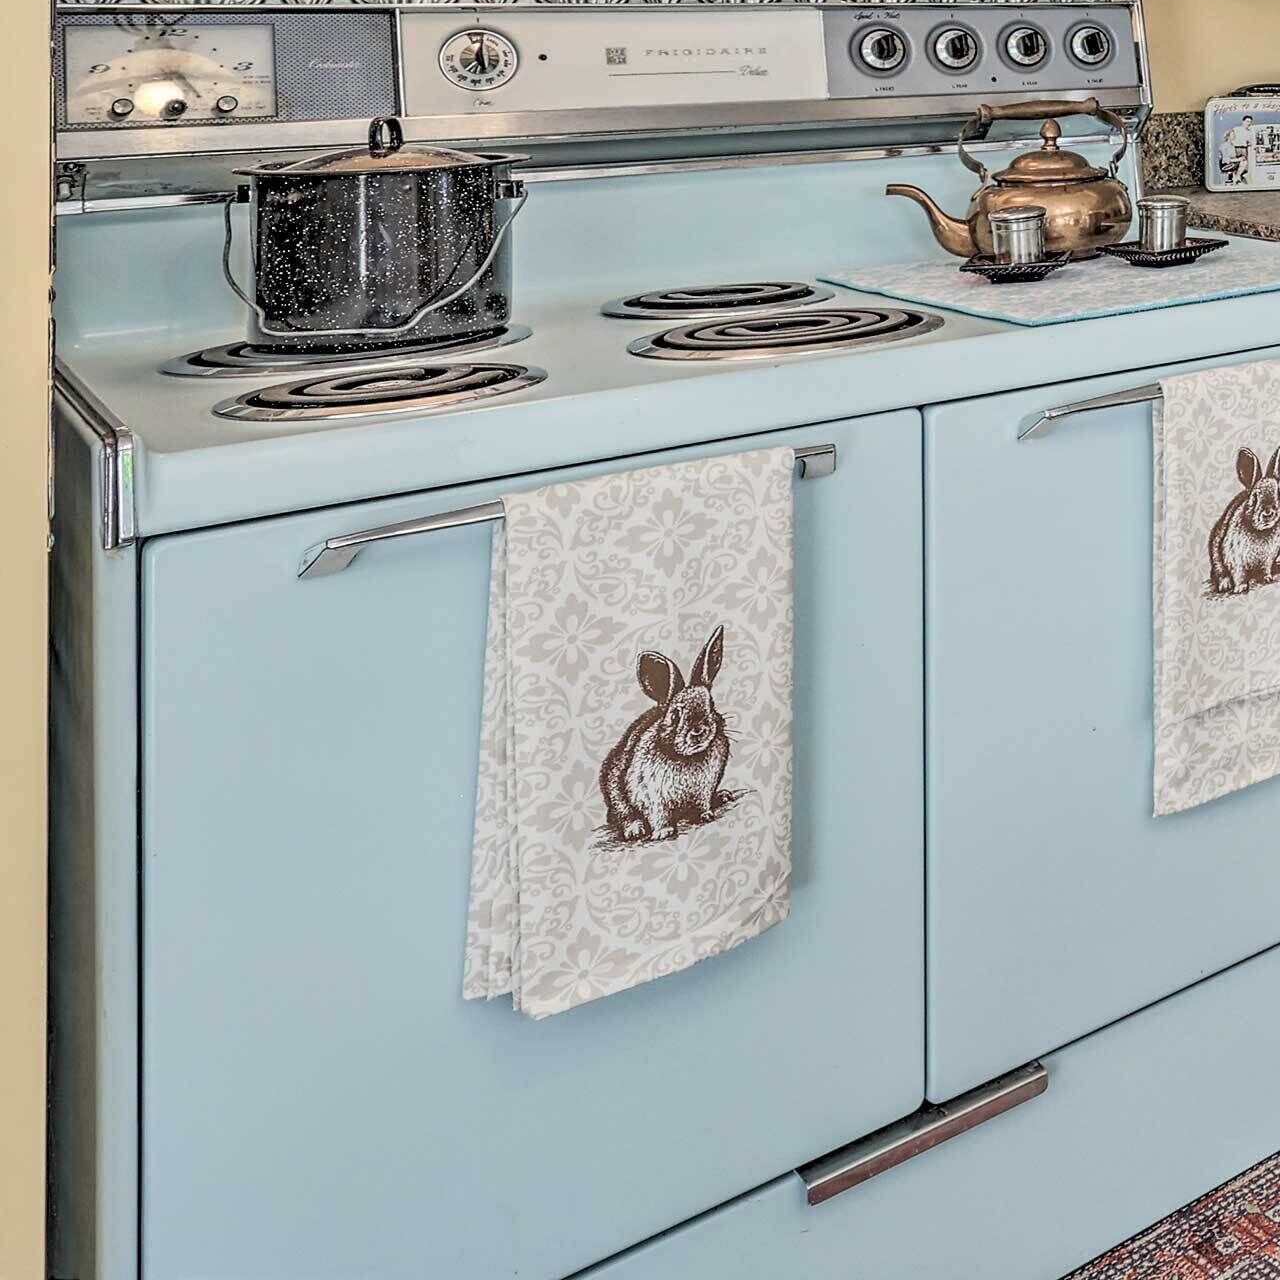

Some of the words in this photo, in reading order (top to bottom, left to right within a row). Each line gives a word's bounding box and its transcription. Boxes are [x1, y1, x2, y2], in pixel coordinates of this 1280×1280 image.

[159, 28, 188, 37] 12
[644, 47, 767, 56] FRIGIDAIRE
[88, 63, 111, 74] 9
[232, 61, 254, 71] 3
